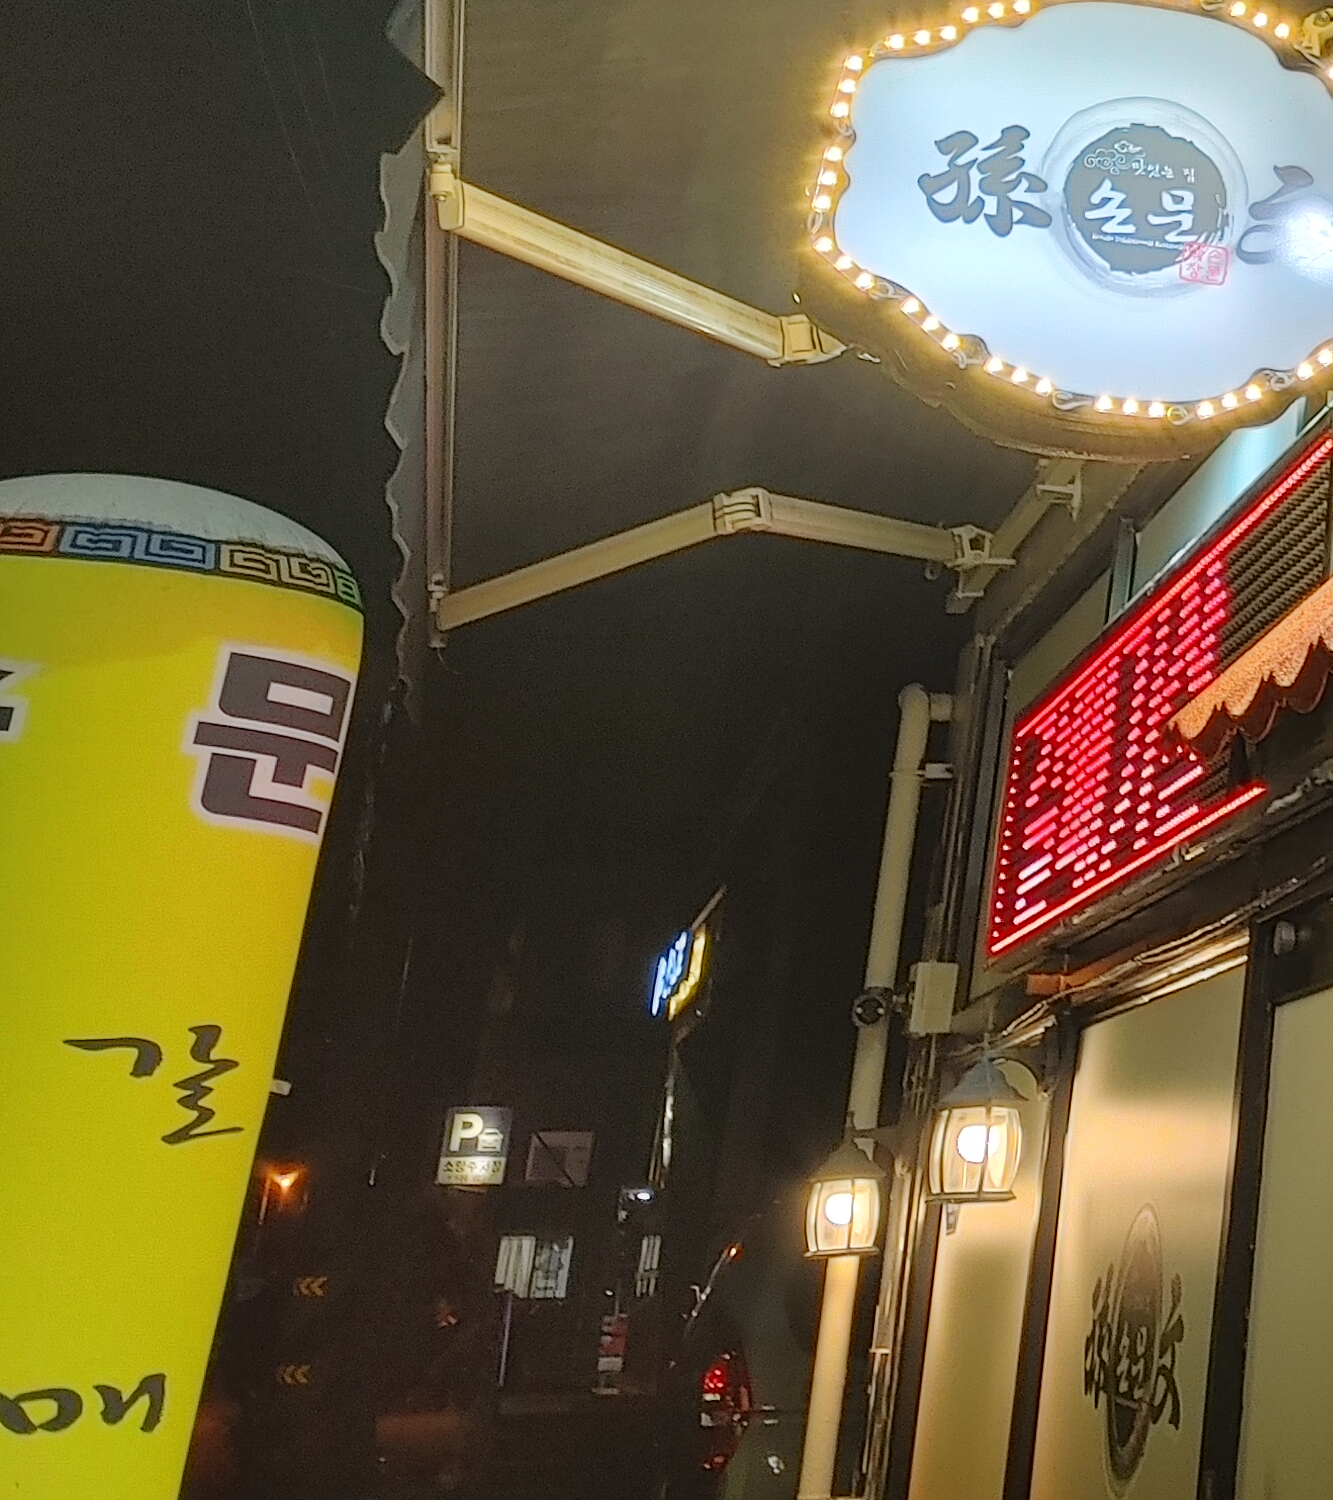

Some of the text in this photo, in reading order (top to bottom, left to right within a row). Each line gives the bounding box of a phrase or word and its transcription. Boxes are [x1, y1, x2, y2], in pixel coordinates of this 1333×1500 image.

[917, 125, 1052, 237] 孫
[1131, 158, 1195, 183] 맛있는 집
[449, 1113, 483, 1152] P
